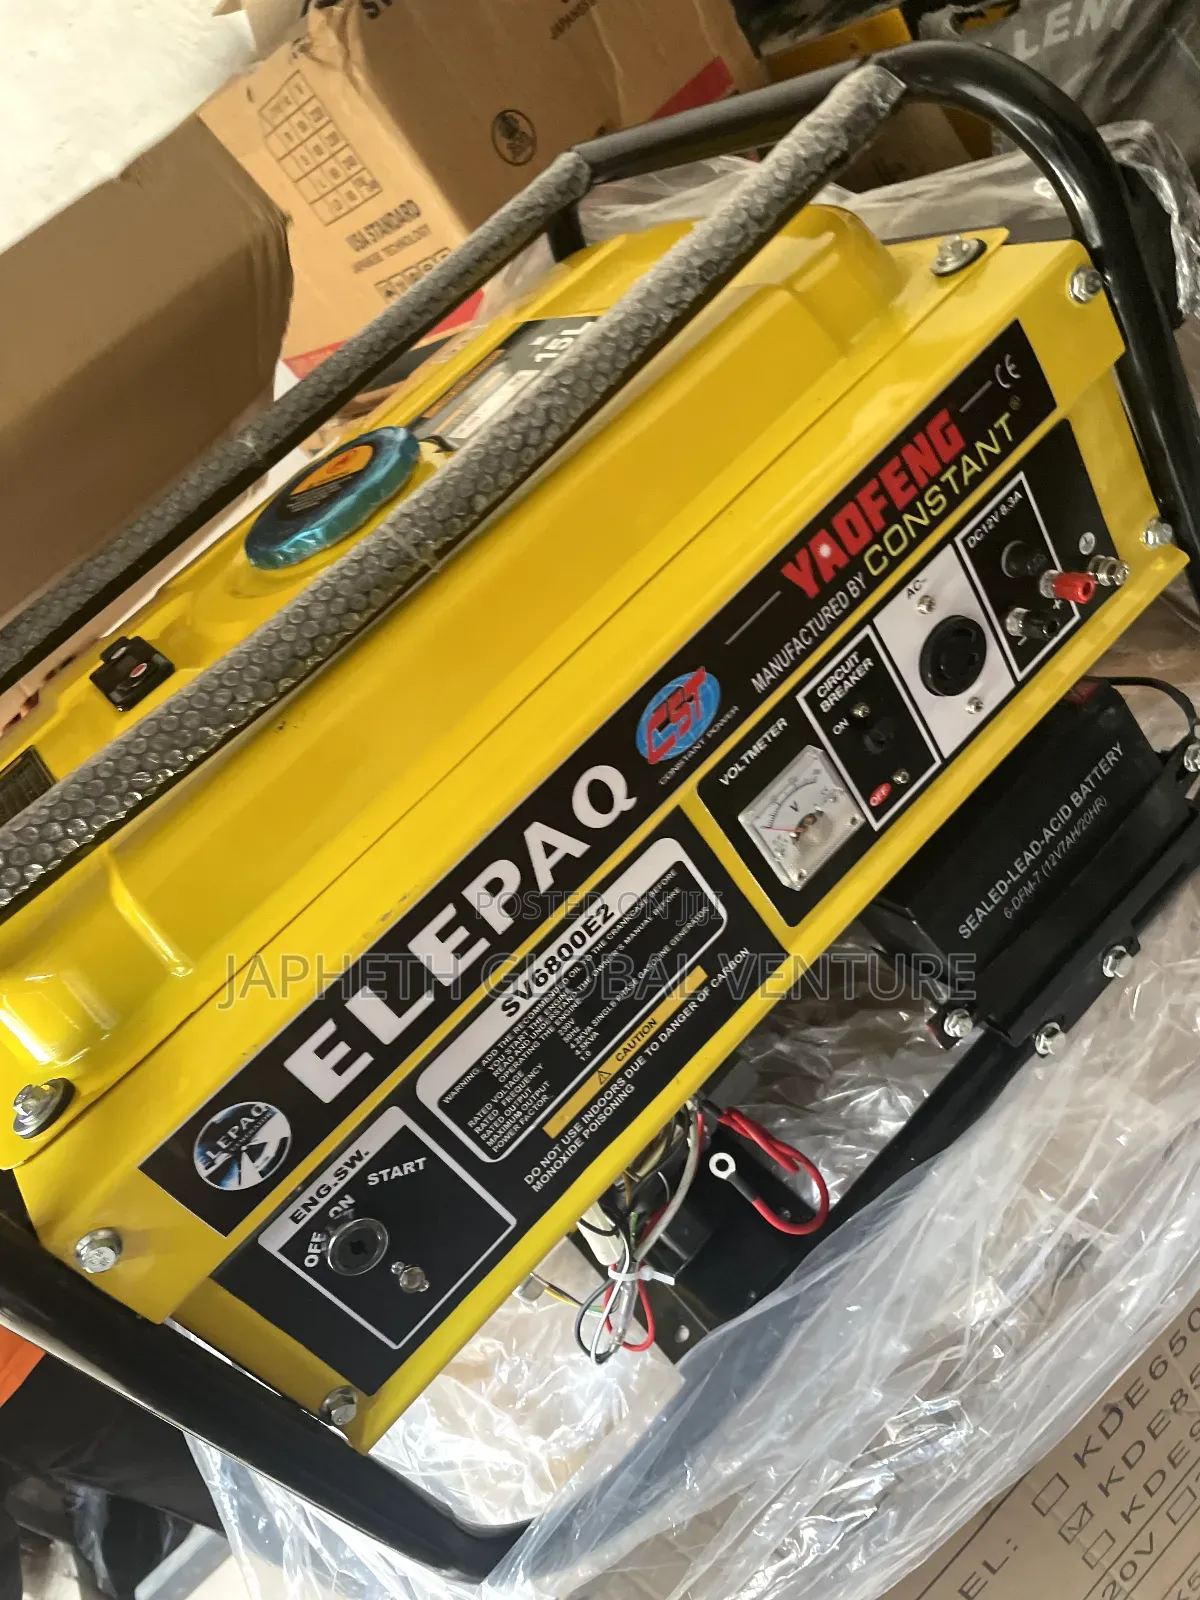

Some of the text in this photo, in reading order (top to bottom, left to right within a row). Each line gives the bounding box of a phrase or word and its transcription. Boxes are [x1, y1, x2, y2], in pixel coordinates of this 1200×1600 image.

[781, 408, 965, 599] YAOFENG
[967, 510, 1000, 549] DC12V
[751, 591, 850, 694] MANUFACTURED
[847, 572, 868, 598] BY
[863, 412, 1013, 577] CONSTANT
[816, 651, 861, 699] CIRCUIT
[819, 657, 875, 713] BREAKER
[646, 666, 706, 764] CST
[831, 717, 850, 736] ON
[719, 716, 788, 786] VOLTMETER
[957, 741, 1124, 939] SEALED-LEAD-ACID BATTERY
[283, 764, 637, 1103] ELEPAQ
[501, 903, 614, 1018] SV6800E2
[481, 1048, 499, 1067] ADD
[498, 1032, 515, 1049] THE
[512, 978, 569, 1034] RECOMMENDED
[568, 966, 583, 979] OIL
[591, 939, 608, 954] THE
[648, 869, 678, 899] BEFORE
[492, 1055, 515, 1078] READ
[514, 1039, 531, 1057] AND
[529, 991, 577, 1040] UNDERSTAND
[577, 976, 593, 991] THE
[623, 916, 653, 945] MANUAL
[488, 1055, 506, 1071] YOU
[505, 1031, 530, 1055] START
[528, 1014, 544, 1031] THE
[557, 1018, 575, 1036] 230V
[590, 1000, 618, 1027] SINGLE
[615, 1018, 658, 1062] CAUTION
[498, 1040, 541, 1083] OPERATING
[539, 1025, 556, 1041] THE
[524, 947, 750, 1185] DO NOT USE INDOORS DUE TO DANGER OF CARBON
[467, 1069, 525, 1128] RATED VOLTAGE
[473, 1062, 544, 1134] RATED FREQUENCY
[480, 1086, 533, 1141] RATED OUTPUT
[486, 1080, 550, 1147] MAXIMUM OUTPUT
[491, 1094, 549, 1153] POWER FACTOR
[531, 1083, 635, 1193] MONOXIDE POISONING
[289, 1148, 370, 1225] ENG.SW.
[367, 1157, 427, 1186] START
[328, 1194, 356, 1220] ON
[304, 1231, 327, 1268] OFF
